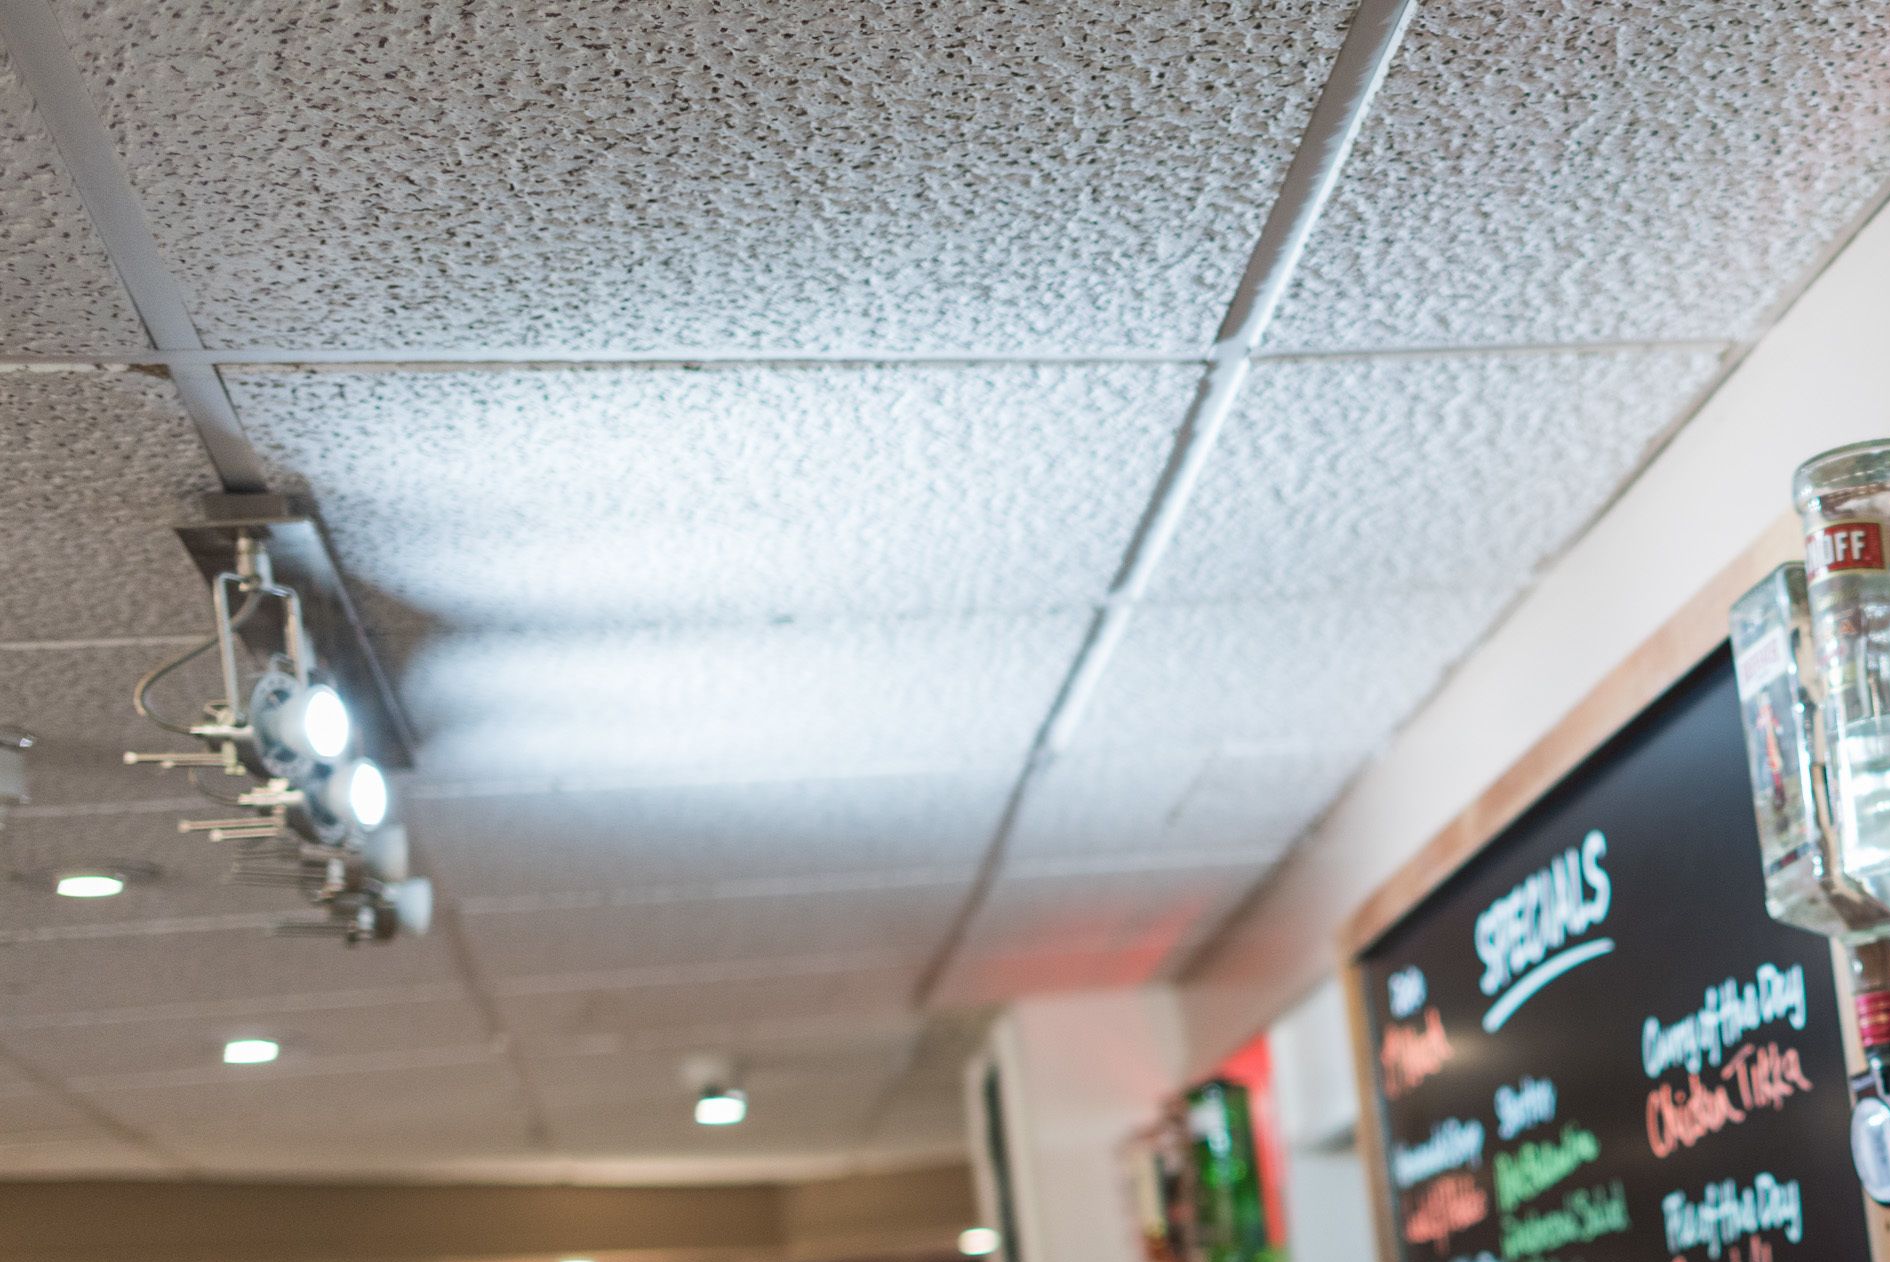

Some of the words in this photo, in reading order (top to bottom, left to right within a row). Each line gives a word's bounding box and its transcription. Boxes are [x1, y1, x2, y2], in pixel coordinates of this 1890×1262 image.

[1474, 829, 1612, 996] SPECIALS
[1756, 962, 1807, 1031] Day
[1720, 1041, 1814, 1111] Tikka
[1754, 1171, 1804, 1244] Day
